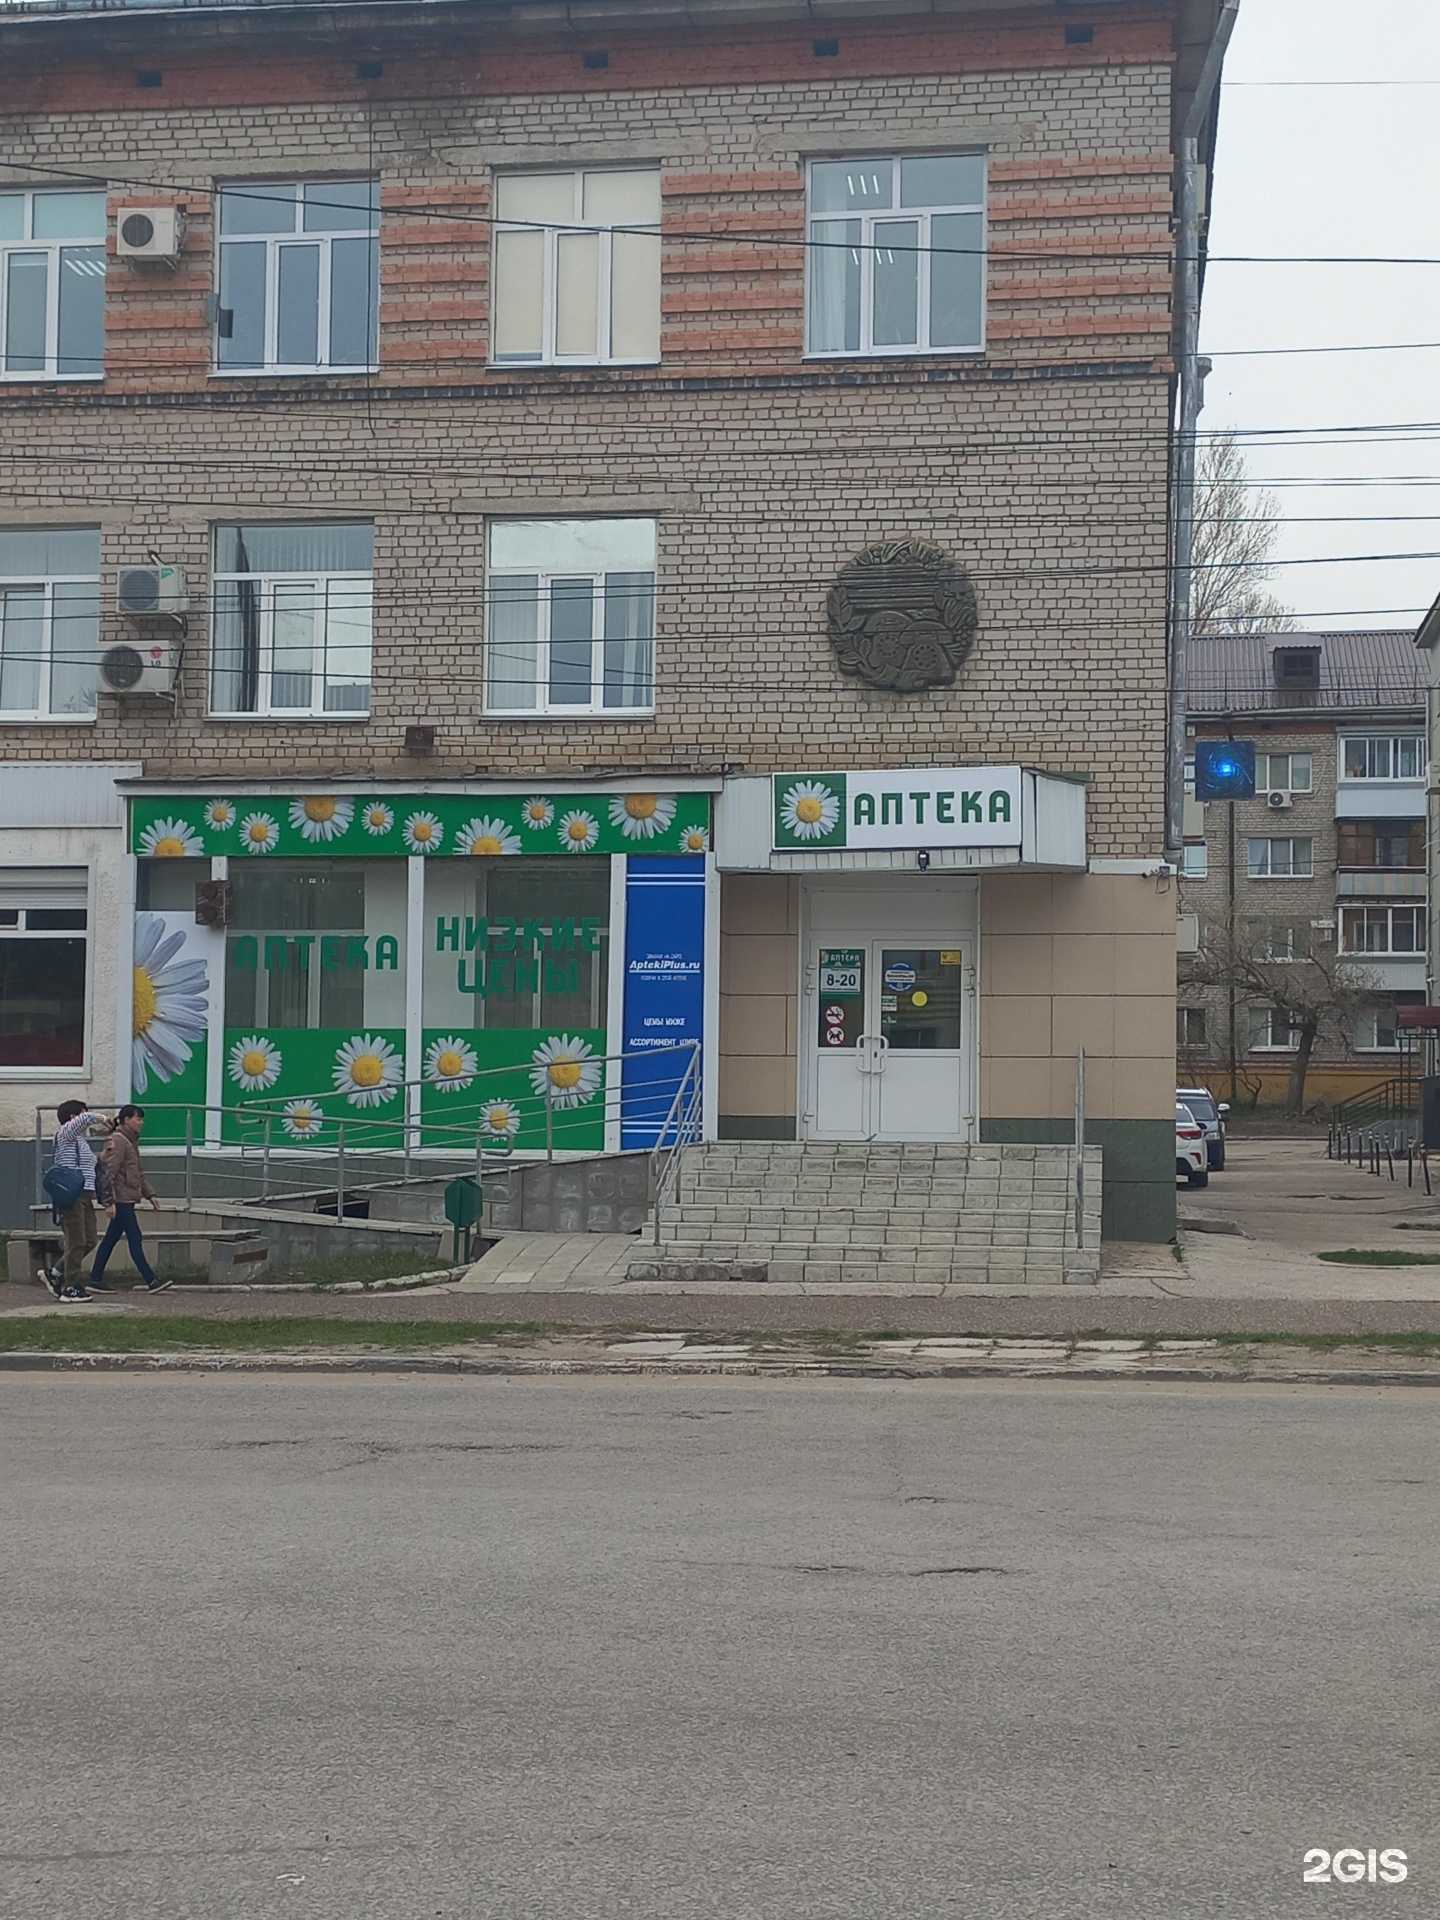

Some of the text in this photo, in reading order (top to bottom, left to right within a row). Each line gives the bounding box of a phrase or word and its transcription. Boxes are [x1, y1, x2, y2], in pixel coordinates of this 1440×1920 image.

[854, 790, 1011, 825] АПТЕКА
[436, 916, 601, 952] НИЗКИЕ
[234, 935, 398, 970] АПТЕКА
[458, 959, 579, 996] ЦЕНЫ
[827, 974, 856, 986] 8-20
